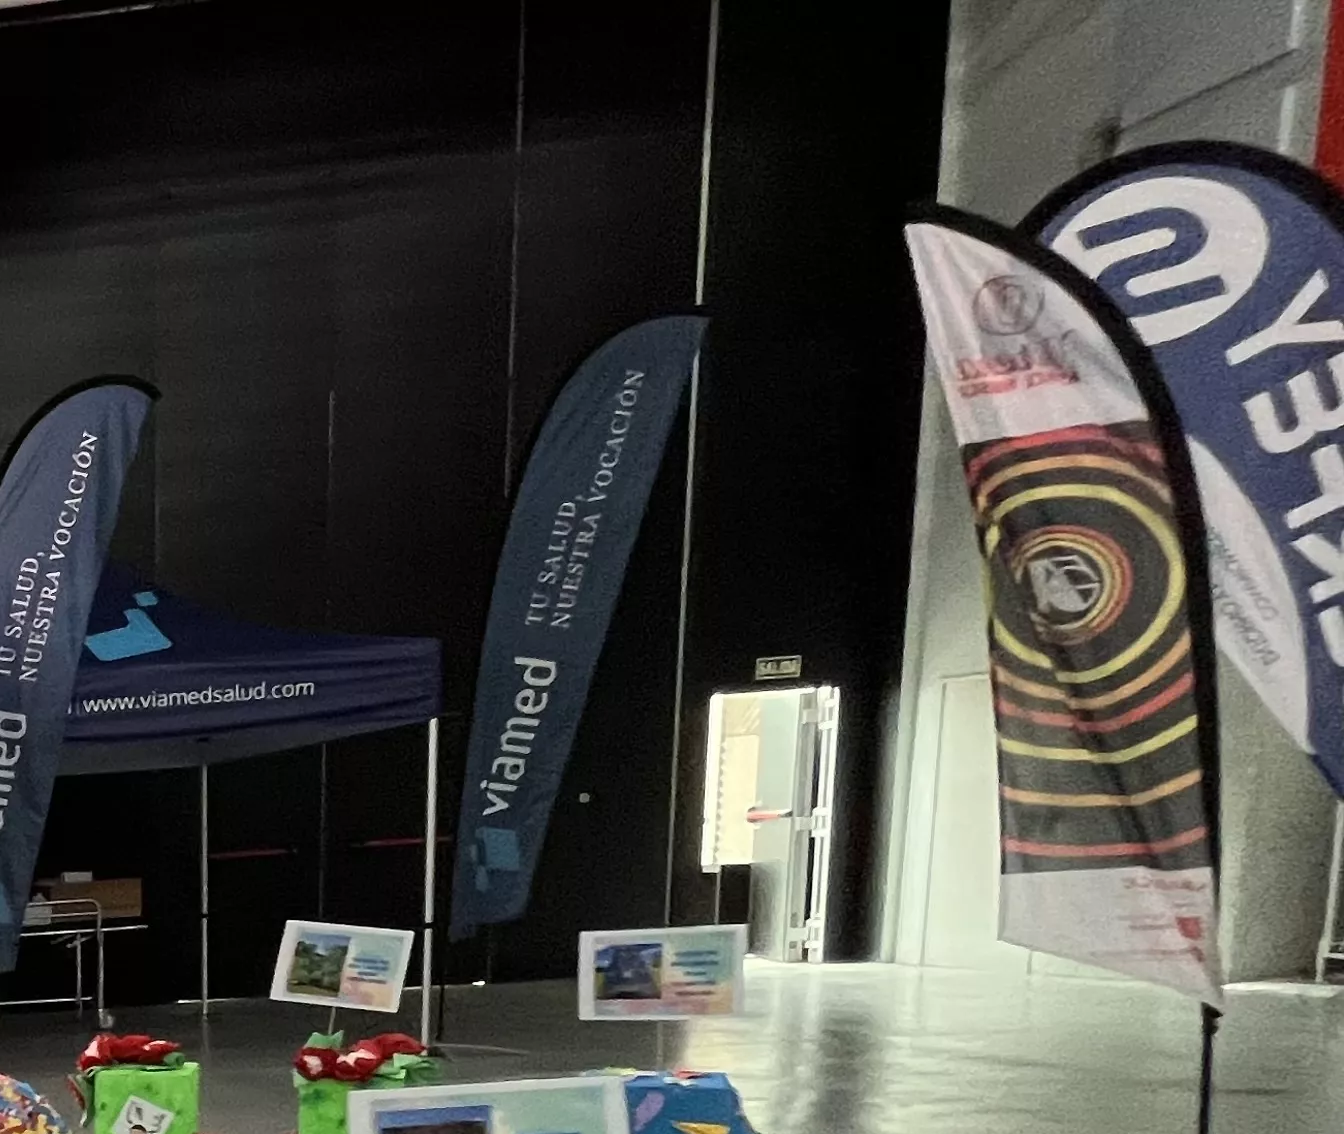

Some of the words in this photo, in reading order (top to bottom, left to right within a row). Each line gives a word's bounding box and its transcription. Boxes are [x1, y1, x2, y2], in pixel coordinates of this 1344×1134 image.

[19, 570, 62, 684] NUESTRA
[48, 430, 99, 564] VOCACIÓN
[524, 589, 552, 627] TU
[538, 493, 584, 586] SALUD,
[549, 512, 602, 630] NUESTRA
[586, 368, 646, 505] VOCACIÓN
[3, 550, 47, 640] SALUD,
[83, 679, 316, 716] www.viamedsalud.com
[481, 656, 558, 818] viamed
